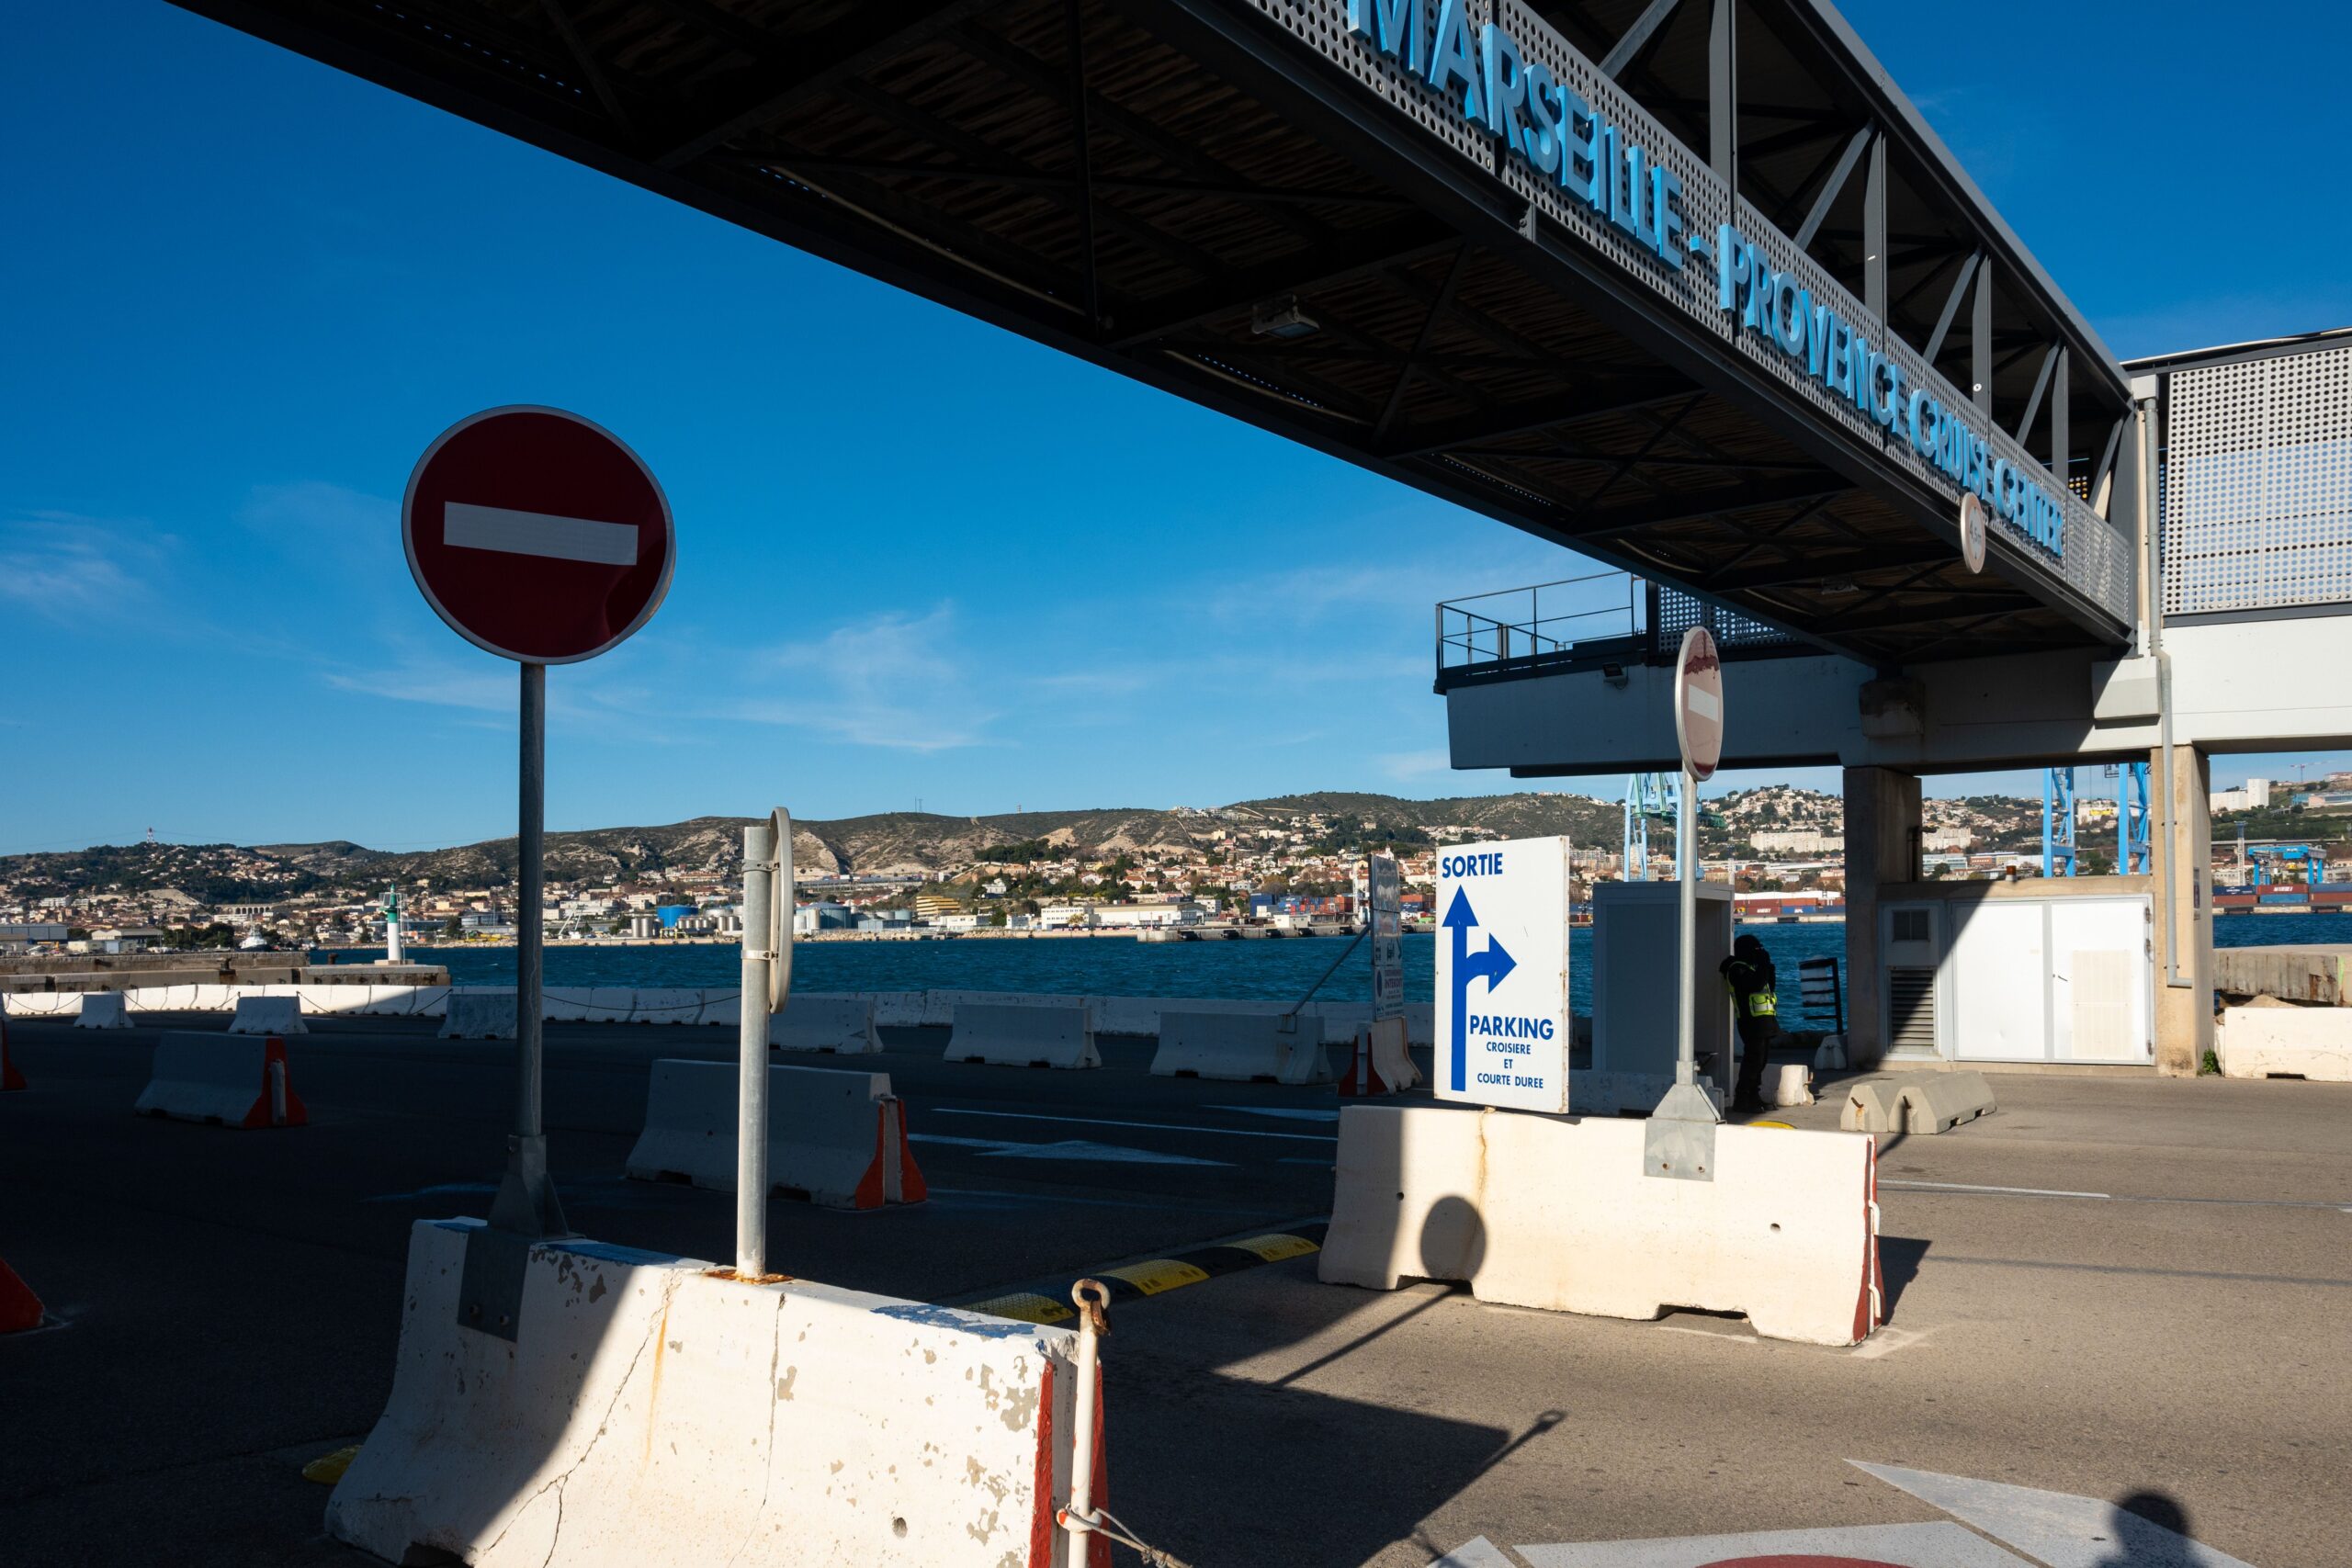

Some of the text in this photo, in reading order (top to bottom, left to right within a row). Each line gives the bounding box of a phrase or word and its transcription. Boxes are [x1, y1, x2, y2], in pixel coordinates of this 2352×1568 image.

[1720, 224, 1907, 441] PROVENCE
[1909, 389, 1994, 504] CRUISE
[1994, 457, 2064, 558] CENTER
[1442, 852, 1503, 878] SORTIE
[1469, 1014, 1555, 1041] PARKING
[1486, 1041, 1532, 1055] CROISIERE
[1503, 1059, 1513, 1069] ET
[1476, 1072, 1544, 1089] COURTE DUREE
